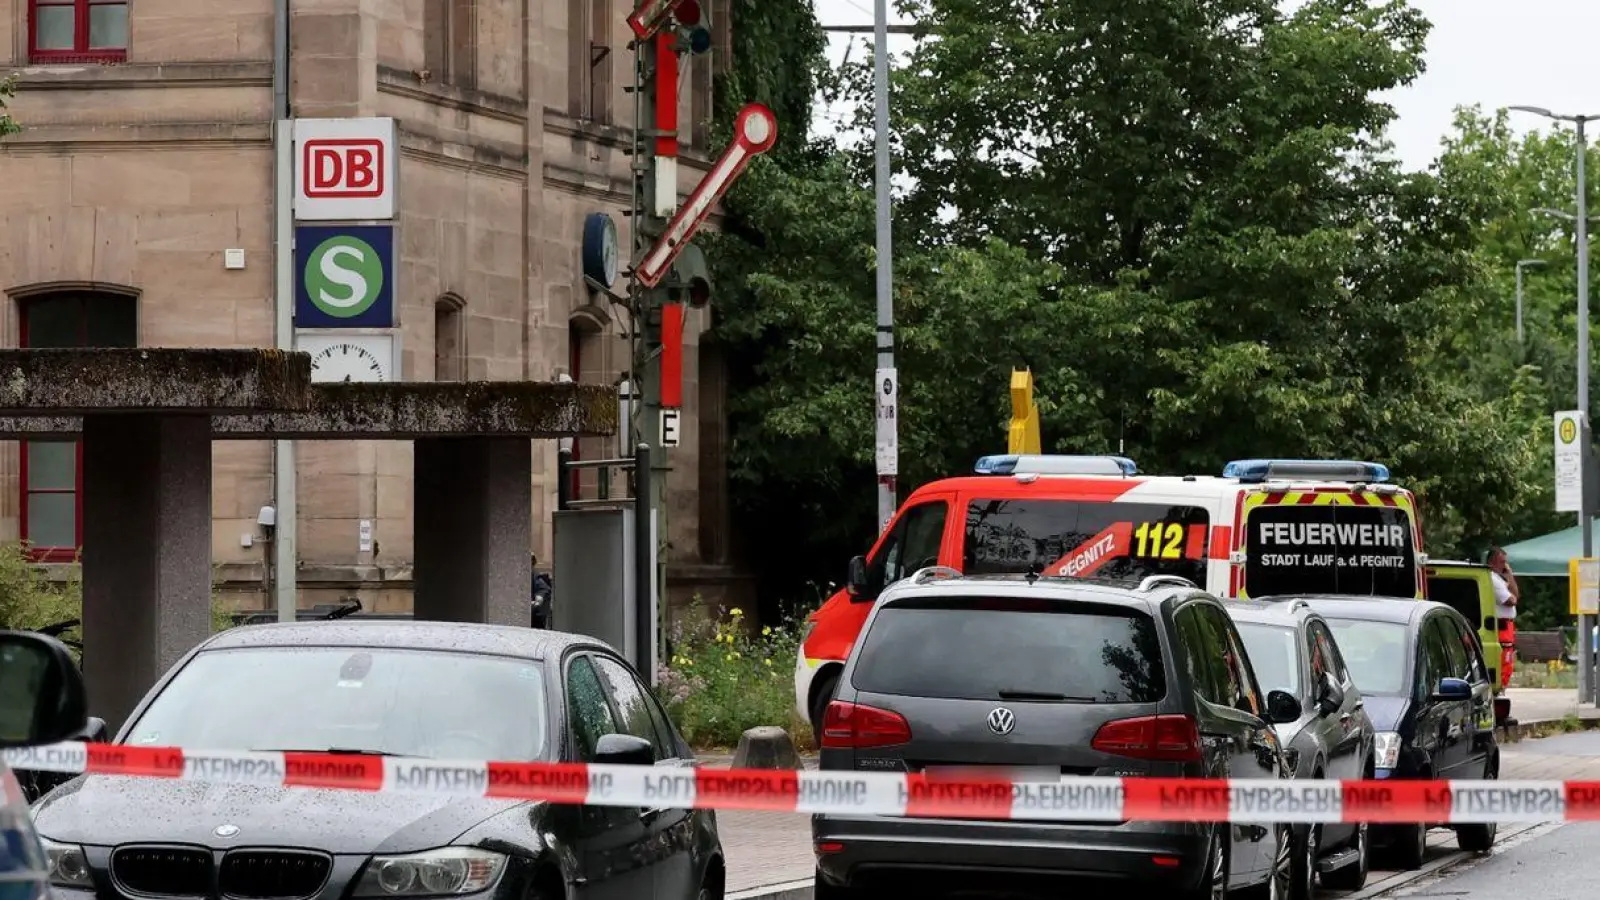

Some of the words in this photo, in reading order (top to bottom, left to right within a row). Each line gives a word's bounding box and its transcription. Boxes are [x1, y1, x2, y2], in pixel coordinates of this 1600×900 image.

[314, 149, 374, 188] DB
[319, 245, 368, 308] S
[663, 414, 677, 444] E
[1135, 522, 1183, 559] 112
[1259, 522, 1405, 547] FEUERWEHR
[1059, 533, 1116, 577] PEGNITZ
[1261, 554, 1302, 566] STADT
[1304, 554, 1334, 567] LAUF
[1337, 556, 1347, 567] a.
[1349, 555, 1359, 567] d.
[1360, 555, 1405, 568] PEGNITZ
